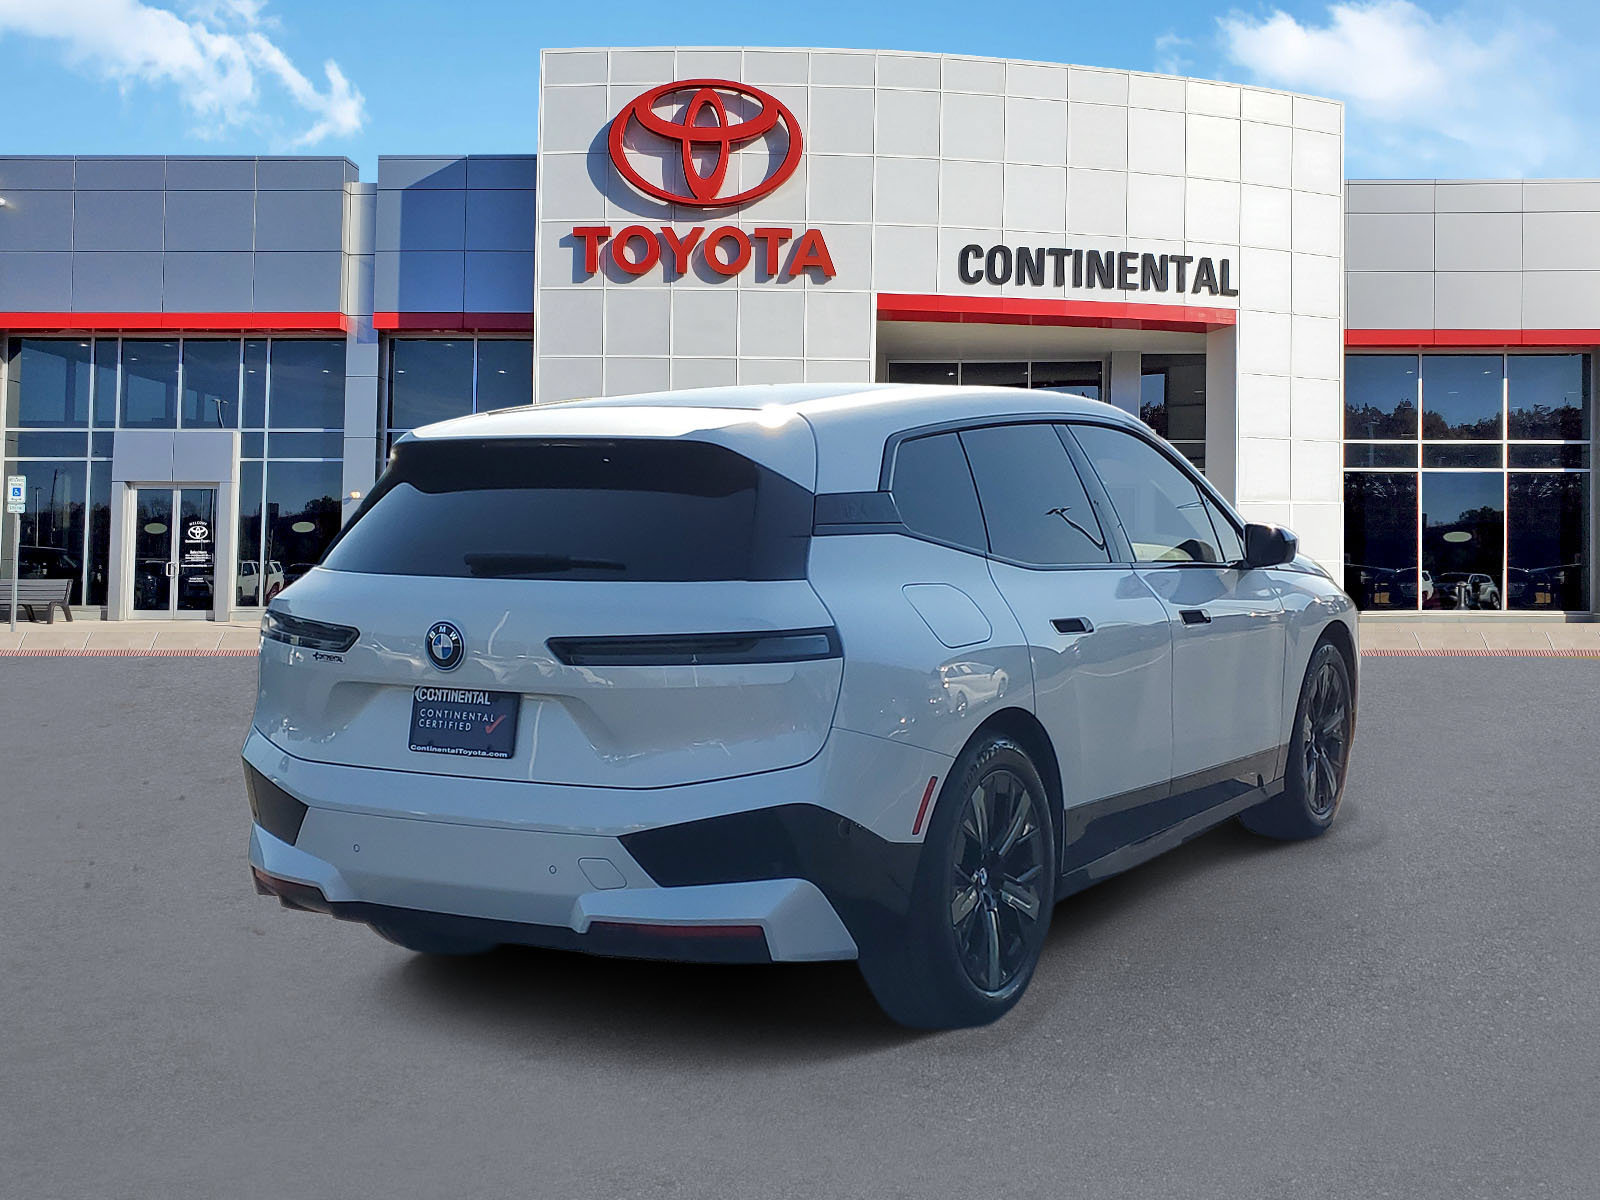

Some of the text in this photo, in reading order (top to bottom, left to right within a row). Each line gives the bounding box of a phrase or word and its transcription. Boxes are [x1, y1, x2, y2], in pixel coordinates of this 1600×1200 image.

[573, 225, 837, 277] TOYOTA
[958, 244, 1239, 297] CONTINENTAL
[429, 626, 458, 641] BMW
[418, 687, 491, 705] CONTINENTAL
[419, 708, 495, 723] CONTINENTAL
[418, 719, 472, 731] CERTIFIED
[410, 744, 508, 758] ContinentalToyota.com
